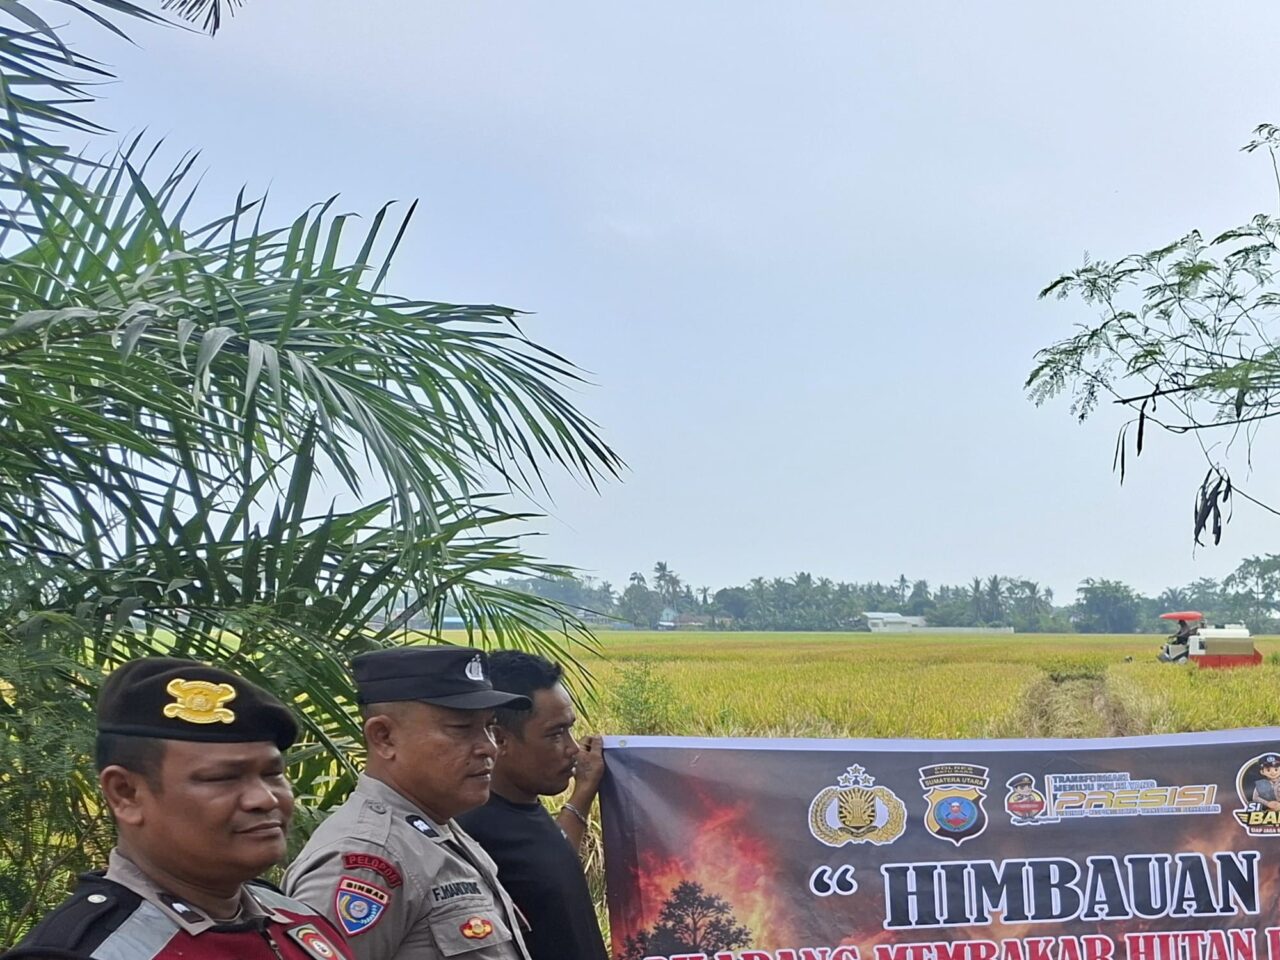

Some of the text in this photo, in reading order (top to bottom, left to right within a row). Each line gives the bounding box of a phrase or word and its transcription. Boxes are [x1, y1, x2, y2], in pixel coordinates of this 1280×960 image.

[925, 777, 984, 786] SUMATERA UTARA
[1056, 786, 1215, 810] PRESISI
[1248, 803, 1260, 811] SI
[346, 882, 384, 900] BINMAS
[880, 850, 1260, 930] HIMBAUAN
